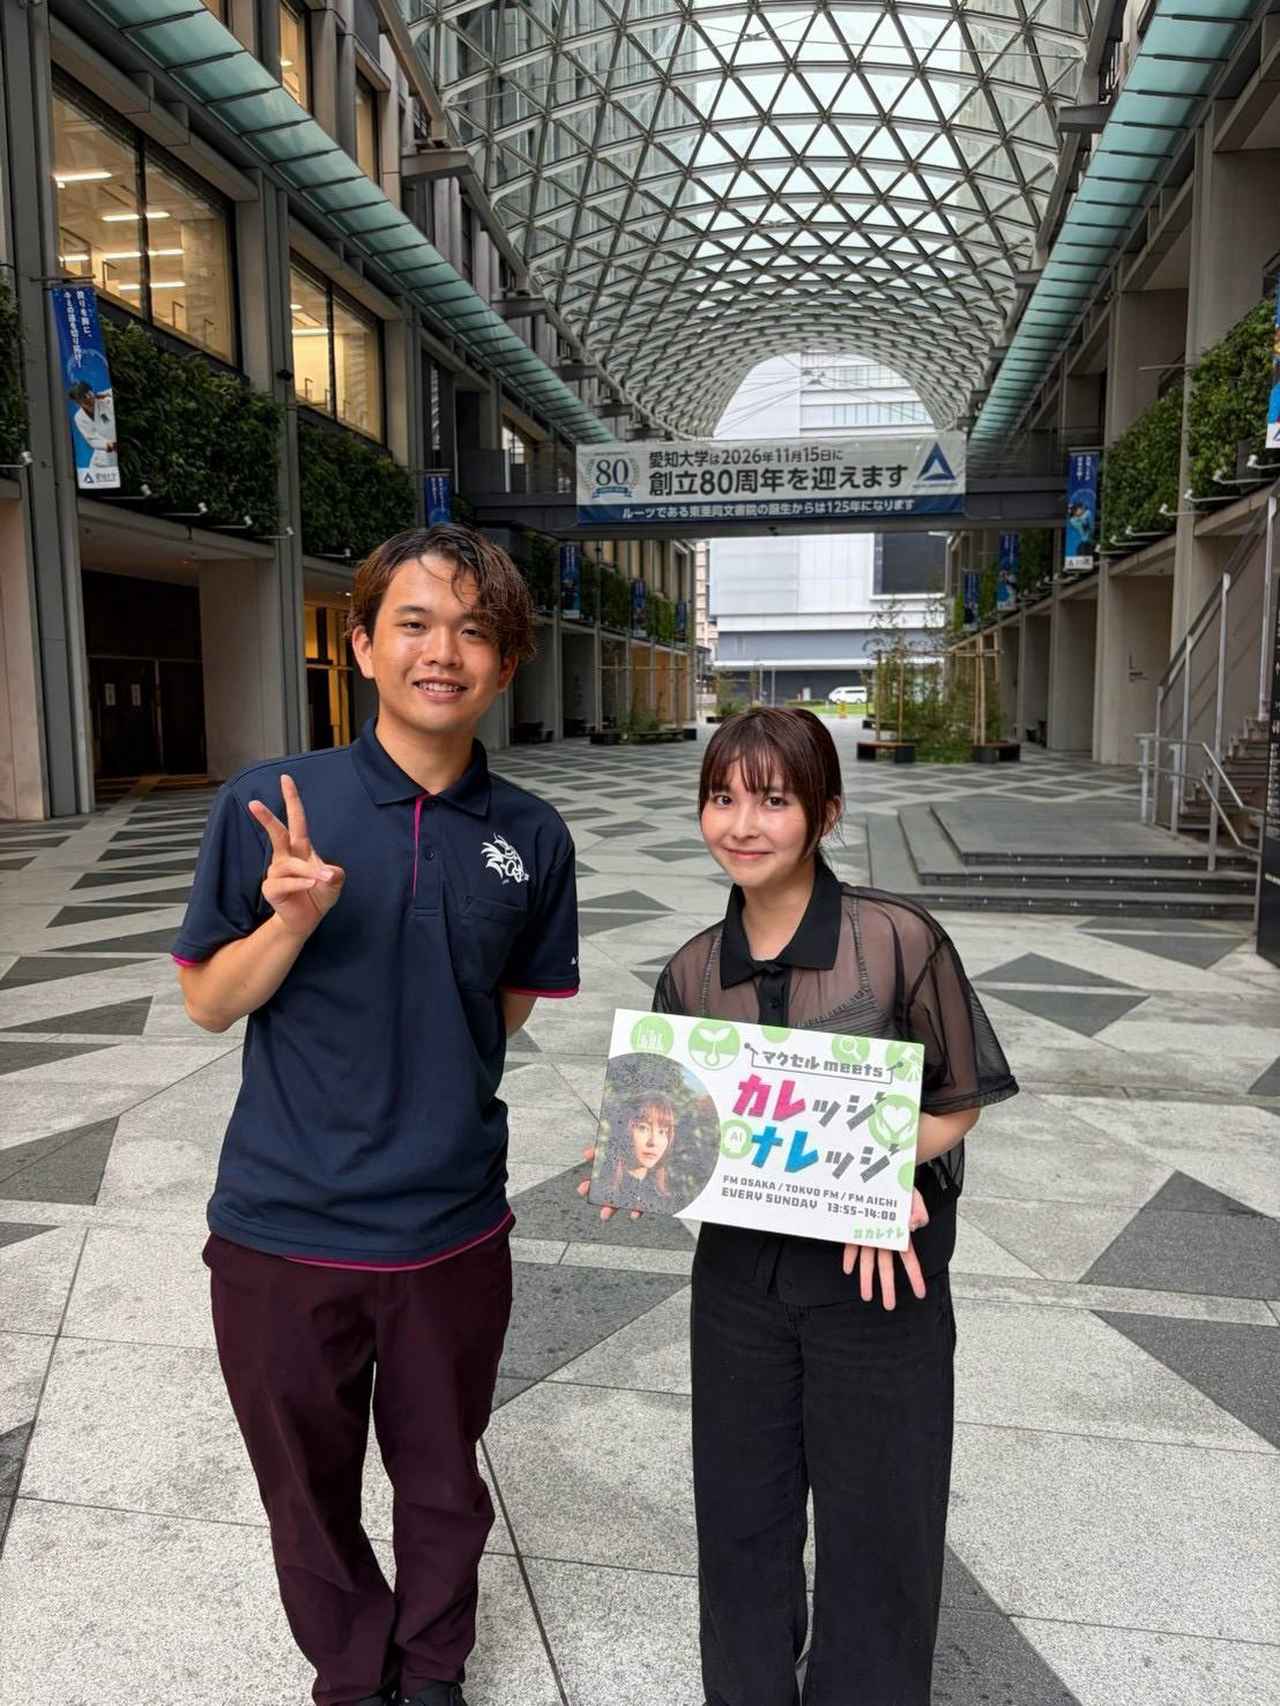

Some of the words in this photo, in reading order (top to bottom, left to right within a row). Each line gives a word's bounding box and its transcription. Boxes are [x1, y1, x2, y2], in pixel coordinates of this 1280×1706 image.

[648, 446, 843, 468] 愛知大学は2026年11月15日に
[596, 459, 629, 486] 80
[648, 464, 908, 497] 創立80周年を迎えます
[762, 1050, 820, 1070] マクセル
[823, 1060, 883, 1078] meets
[732, 1073, 888, 1131] カレッジ
[751, 1125, 901, 1184] ナレッジ
[721, 1186, 763, 1202] EVERY
[765, 1193, 818, 1210] SUNDAY
[723, 1174, 739, 1185] FM
[740, 1177, 777, 1192] OSAKA
[785, 1183, 821, 1198] TOKYO
[823, 1189, 840, 1201] FM
[848, 1193, 865, 1204] FM
[866, 1195, 898, 1209] AICHI
